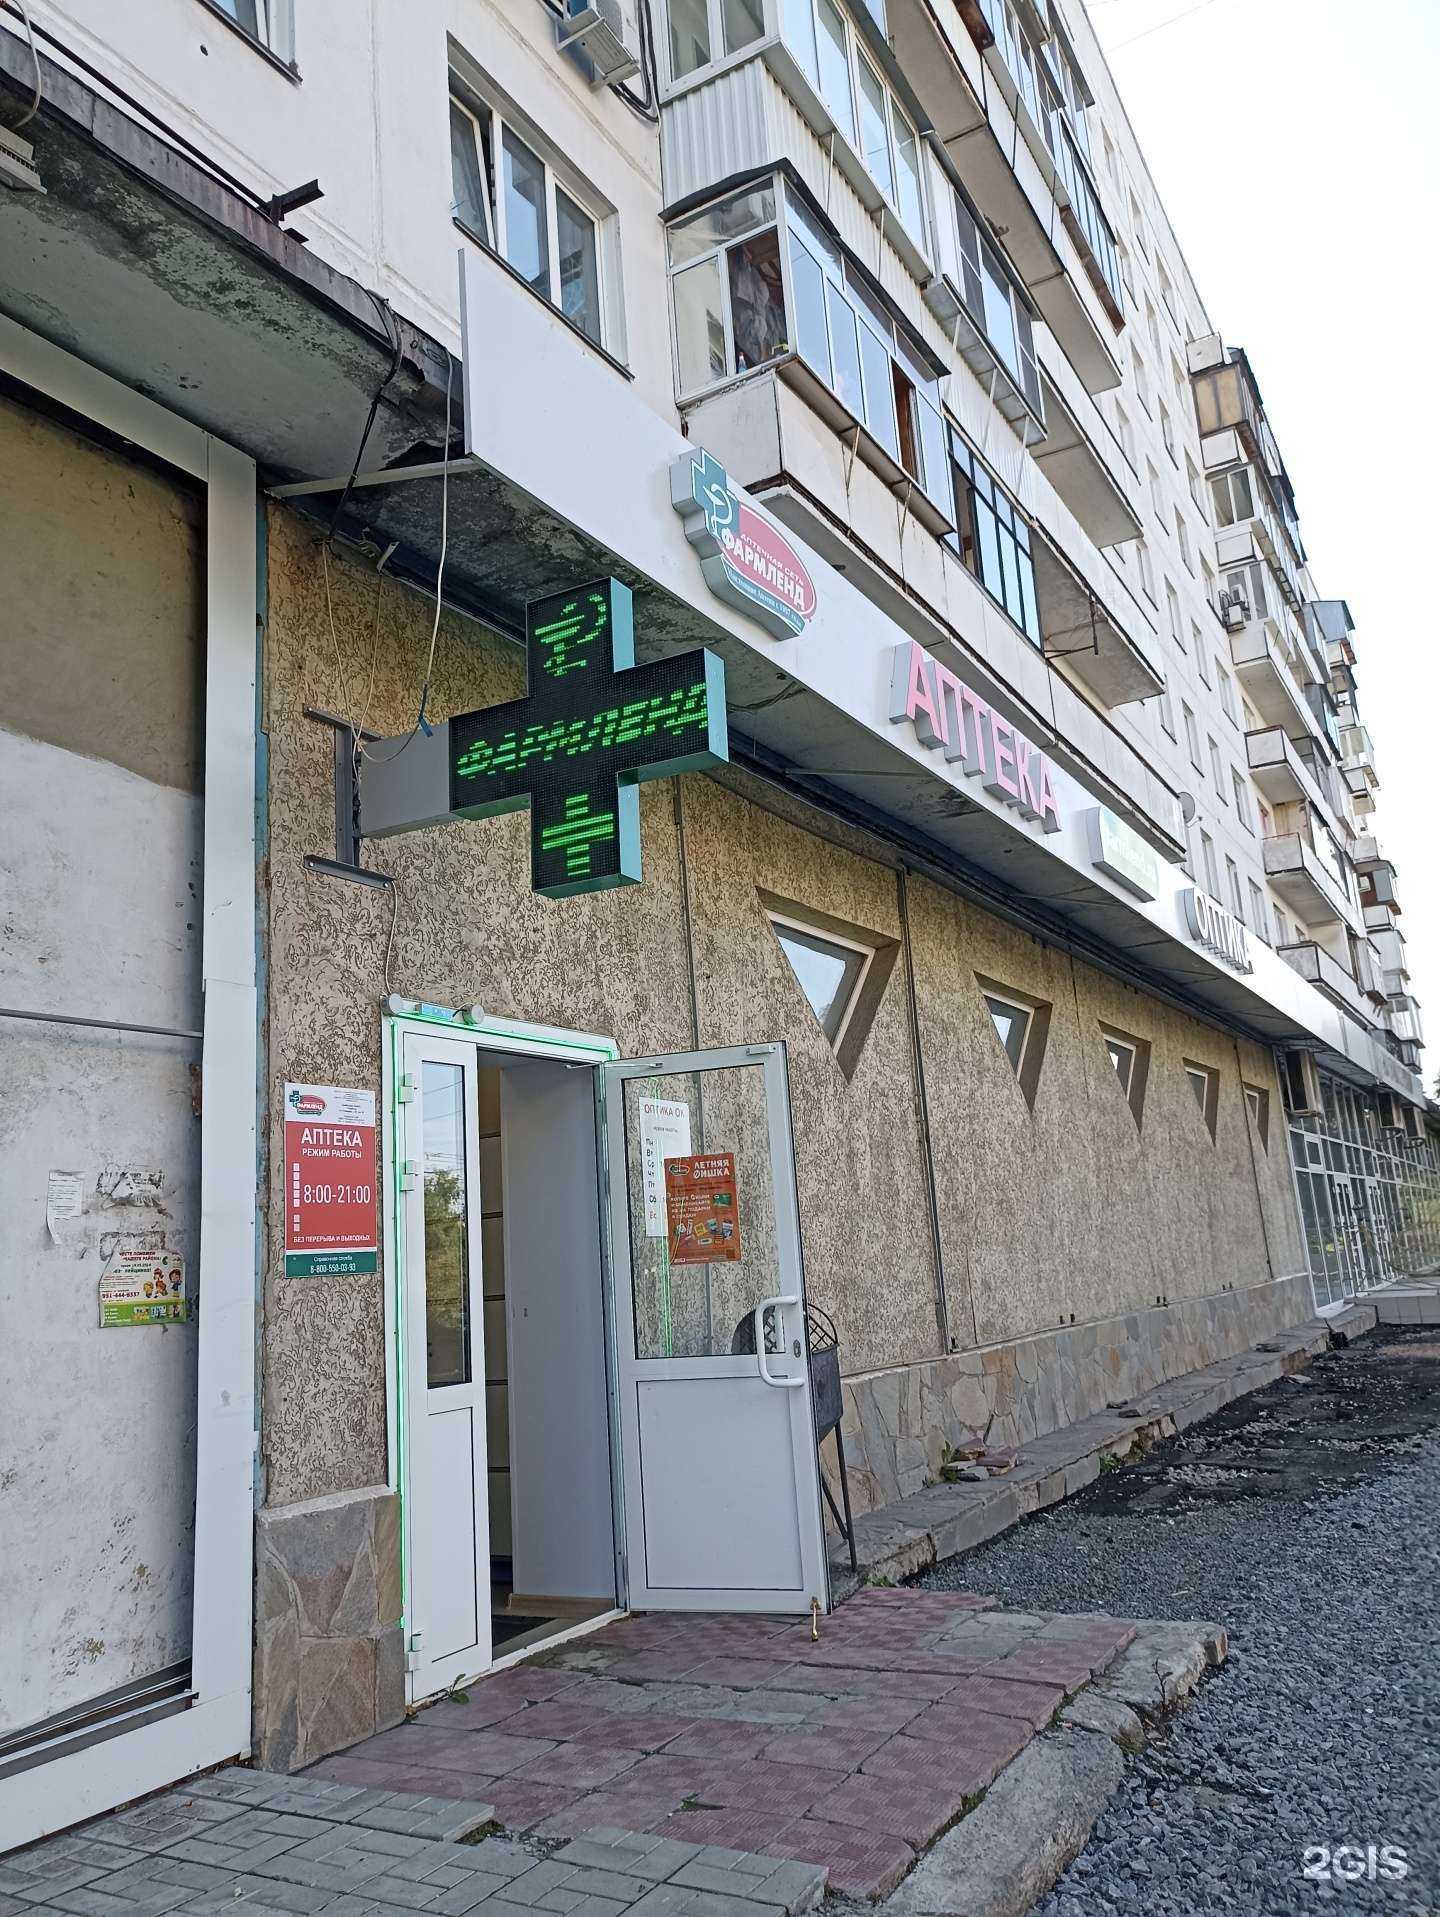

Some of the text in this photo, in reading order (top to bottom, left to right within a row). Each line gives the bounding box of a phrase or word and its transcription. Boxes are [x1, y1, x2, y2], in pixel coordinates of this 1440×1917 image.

[721, 527, 806, 611] ФАРМЛЕНД
[740, 534, 804, 586] АПТЕЧНАЯ СЕТЬ
[457, 682, 709, 779] ФАРМЛЕНД
[905, 641, 1062, 833] АПТЕКА
[644, 1104, 674, 1117] ОПТИКА
[301, 1128, 363, 1147] АПТЕКА
[302, 1148, 362, 1159] РЕЖИМ РАБОТЫ
[694, 1159, 730, 1169] ЛЕТНЯЯ
[303, 1185, 371, 1204] 8:00-21:00
[341, 1234, 370, 1242] ВЫХОДНЫХ
